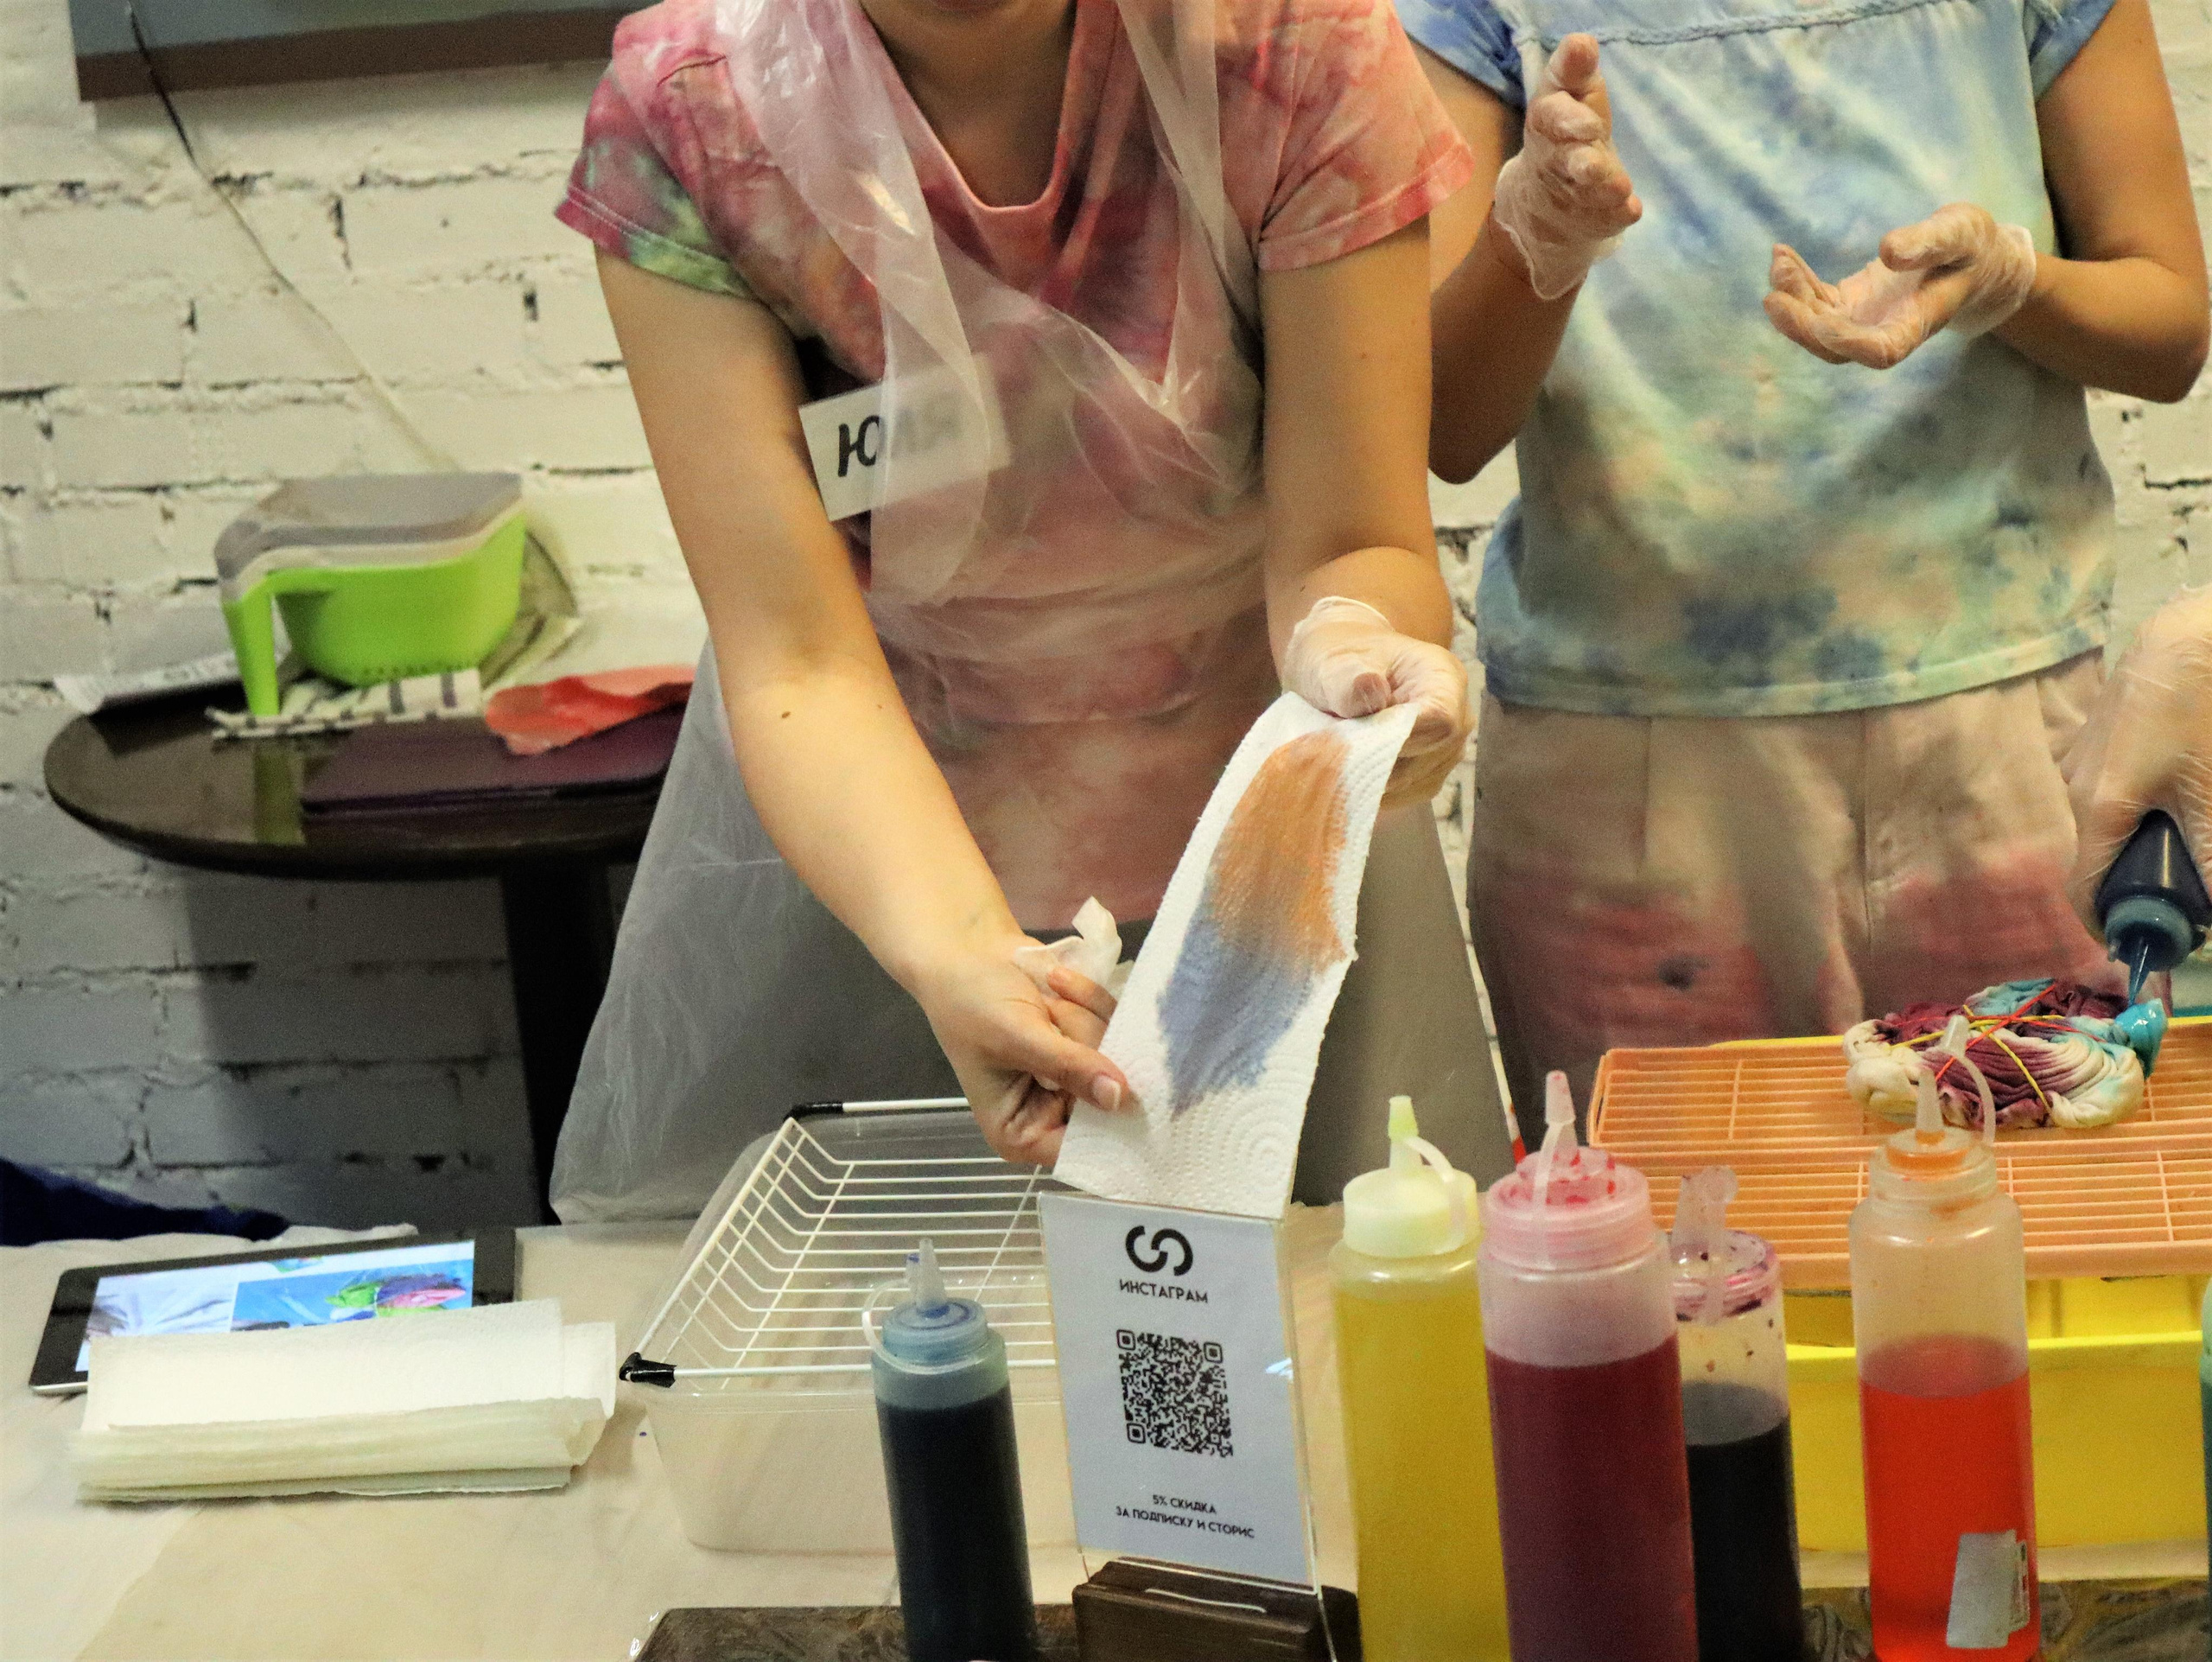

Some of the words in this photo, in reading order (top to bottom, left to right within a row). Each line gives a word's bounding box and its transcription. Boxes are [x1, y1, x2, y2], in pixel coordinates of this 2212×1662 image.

[1119, 1279, 1208, 1303] ИНСТАГРАМ
[1153, 1494, 1167, 1506] 5%
[1170, 1497, 1217, 1514] СКИДКА
[1116, 1506, 1129, 1518] ЗА
[1133, 1508, 1193, 1528] ПОДПИСКУ
[1197, 1519, 1206, 1531] И
[1209, 1521, 1255, 1538] СТОРИС
